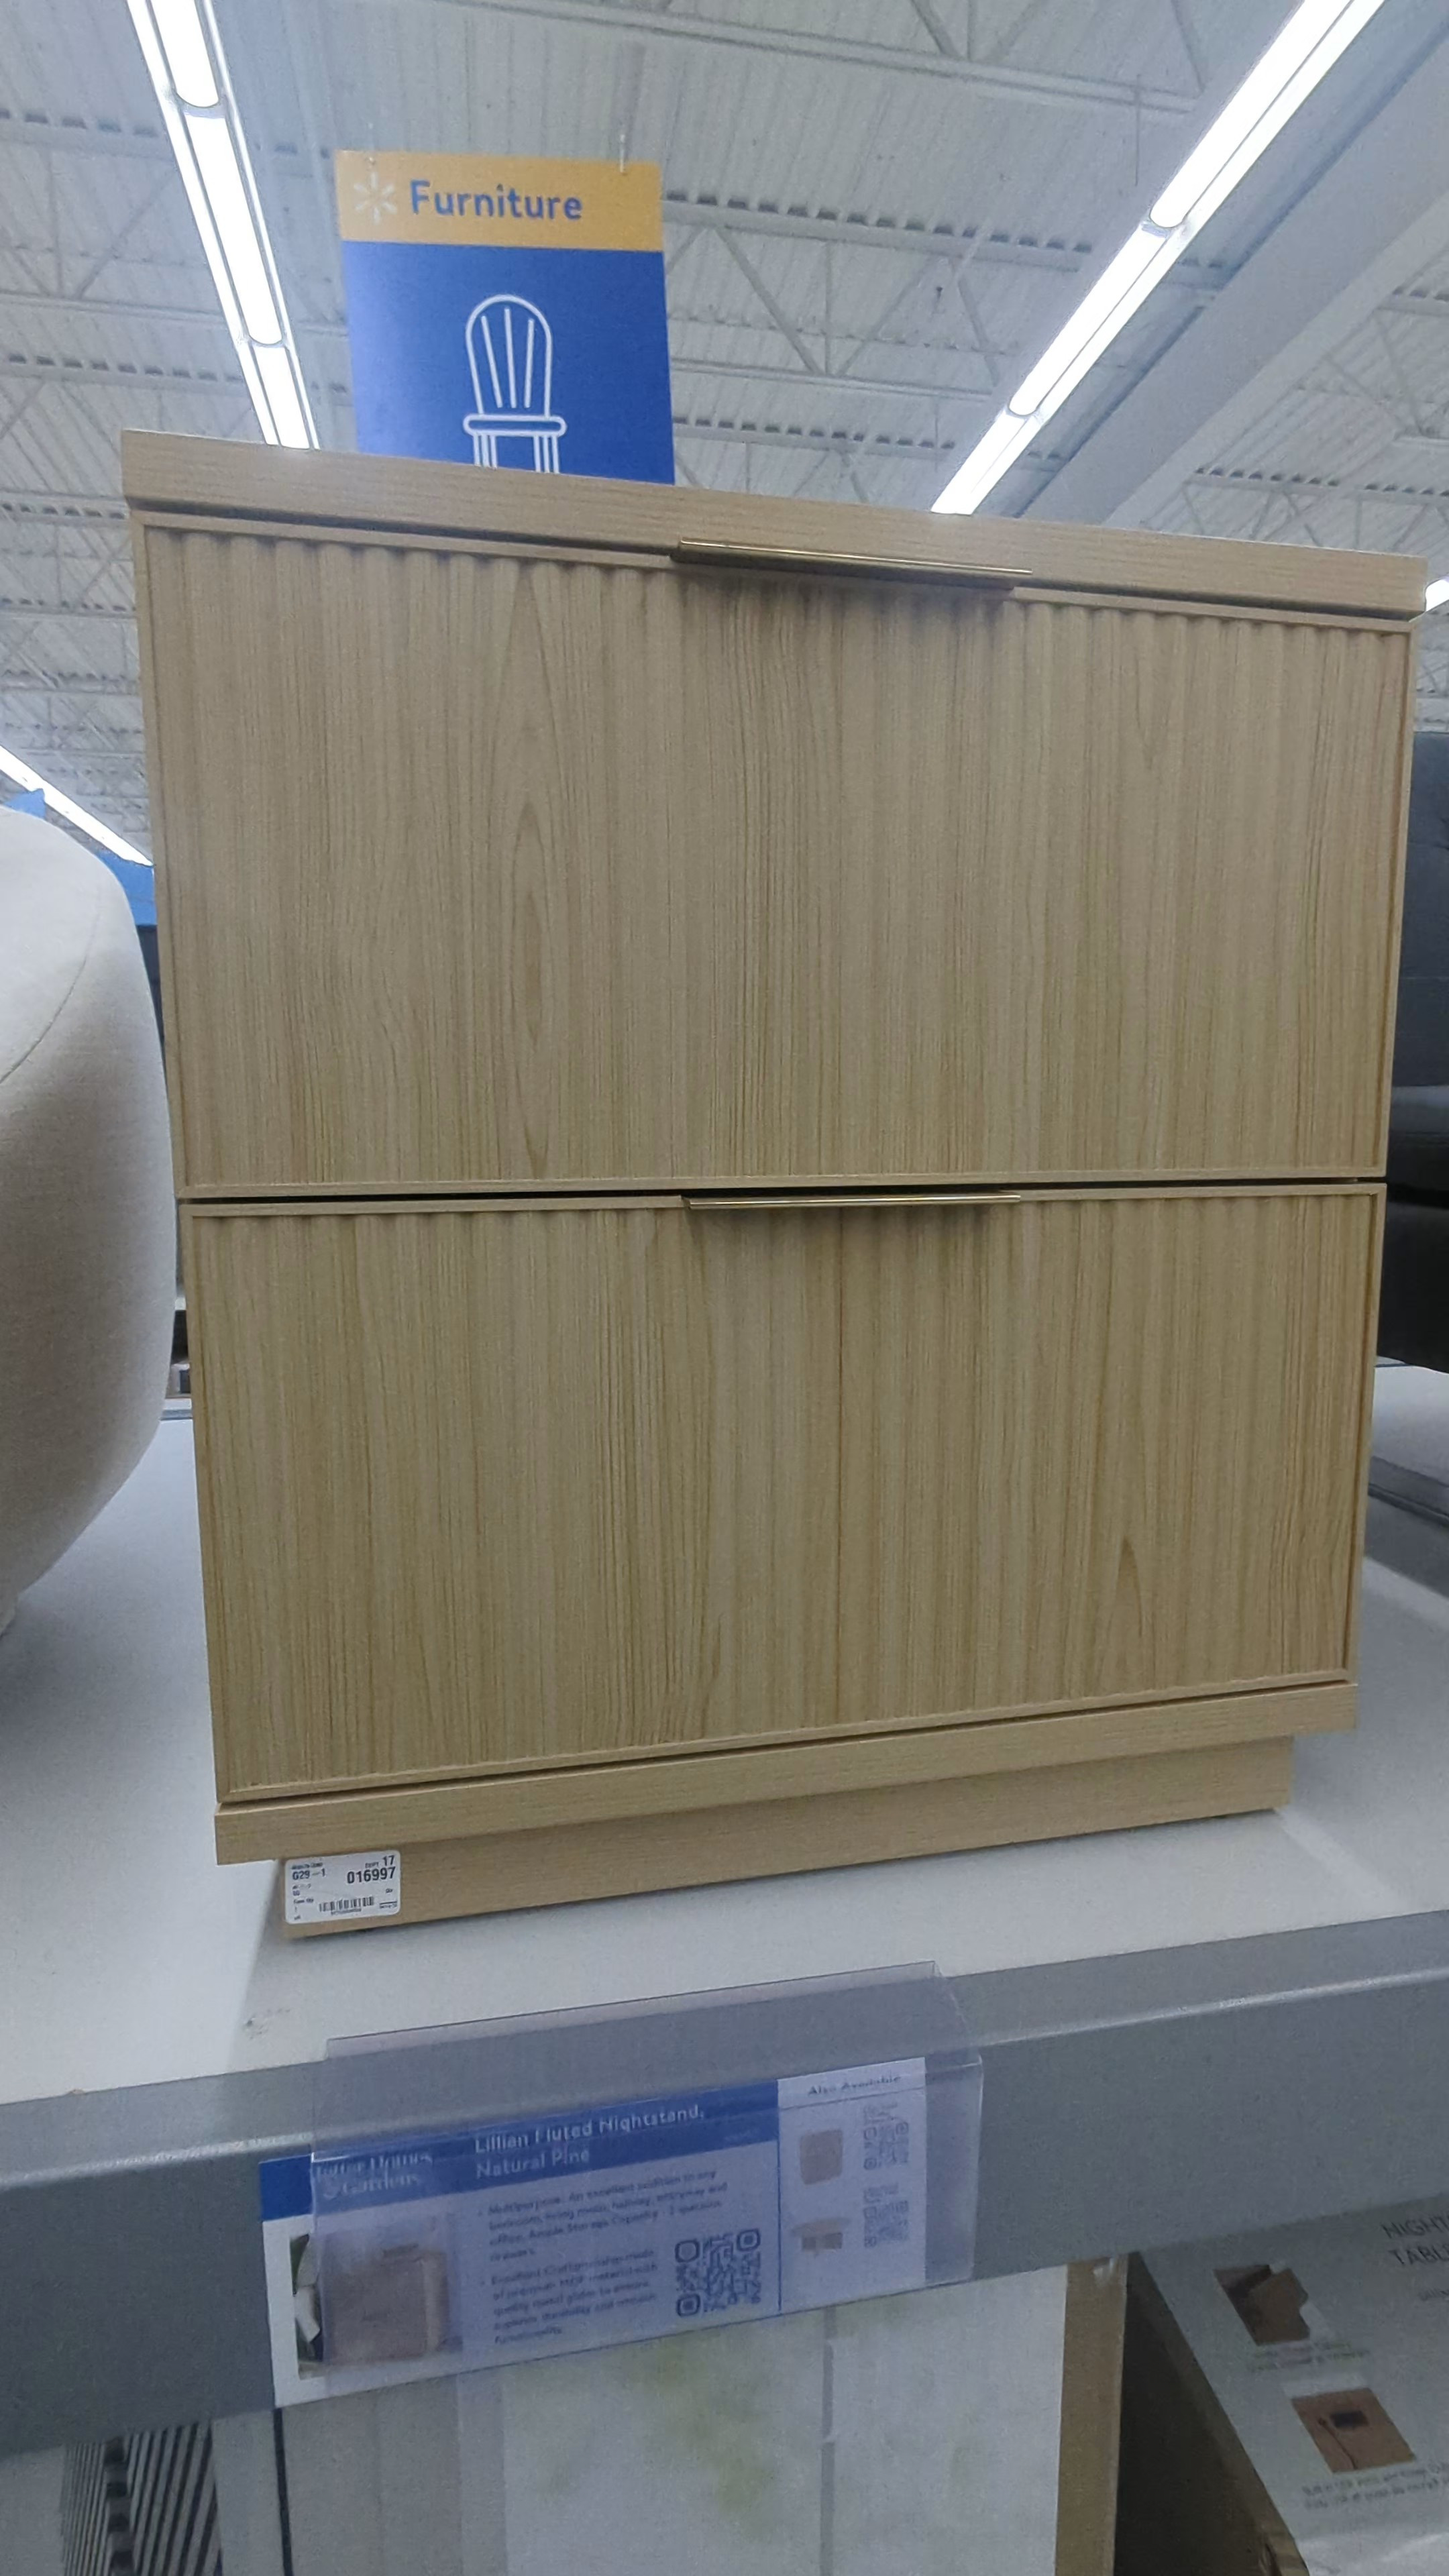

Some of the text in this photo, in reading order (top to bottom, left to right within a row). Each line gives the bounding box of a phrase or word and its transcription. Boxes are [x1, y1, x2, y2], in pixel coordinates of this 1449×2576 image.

[410, 179, 583, 220] Furniture
[382, 1855, 394, 1867] 17
[347, 1866, 396, 1884] 016997
[475, 2133, 529, 2154] Lillian
[476, 2149, 590, 2179] Natural Pine
[1380, 2213, 1449, 2239] NIGHT
